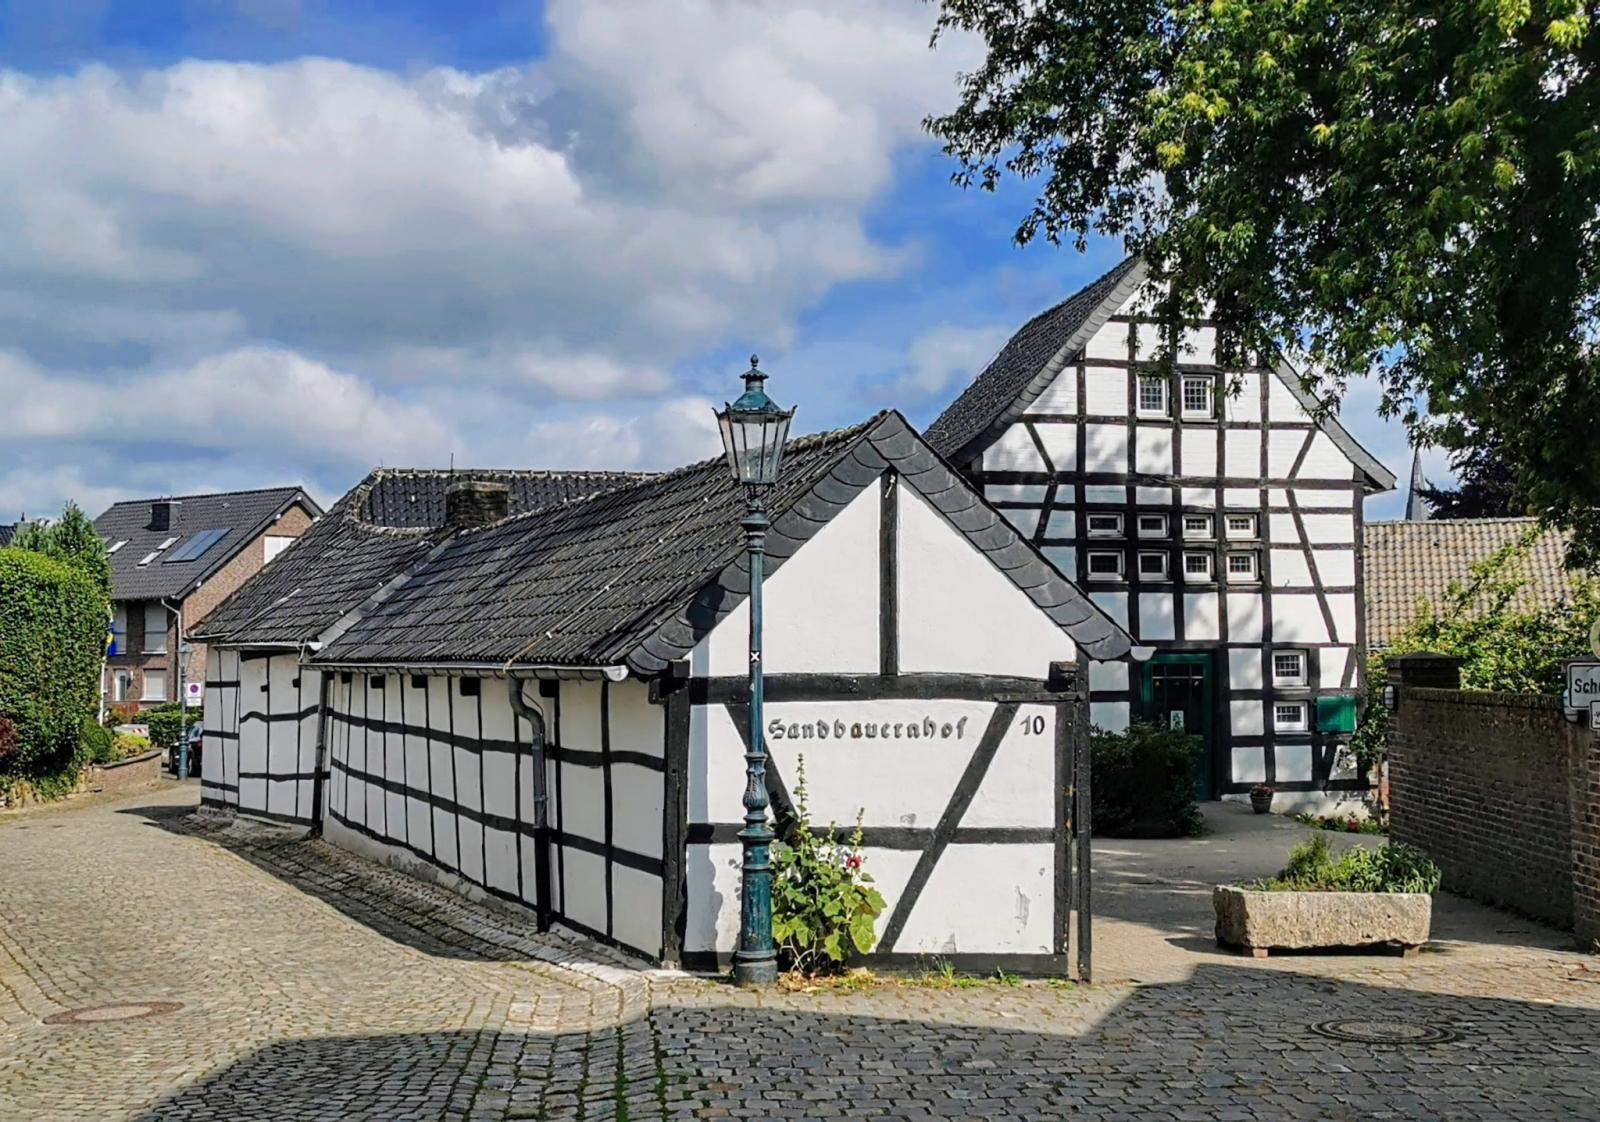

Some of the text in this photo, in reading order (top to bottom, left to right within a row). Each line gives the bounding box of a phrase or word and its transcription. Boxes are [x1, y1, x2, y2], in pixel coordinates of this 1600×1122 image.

[1574, 678, 1600, 693] Sch
[768, 715, 968, 740] Sandbauernhof
[1019, 715, 1045, 736] 10
